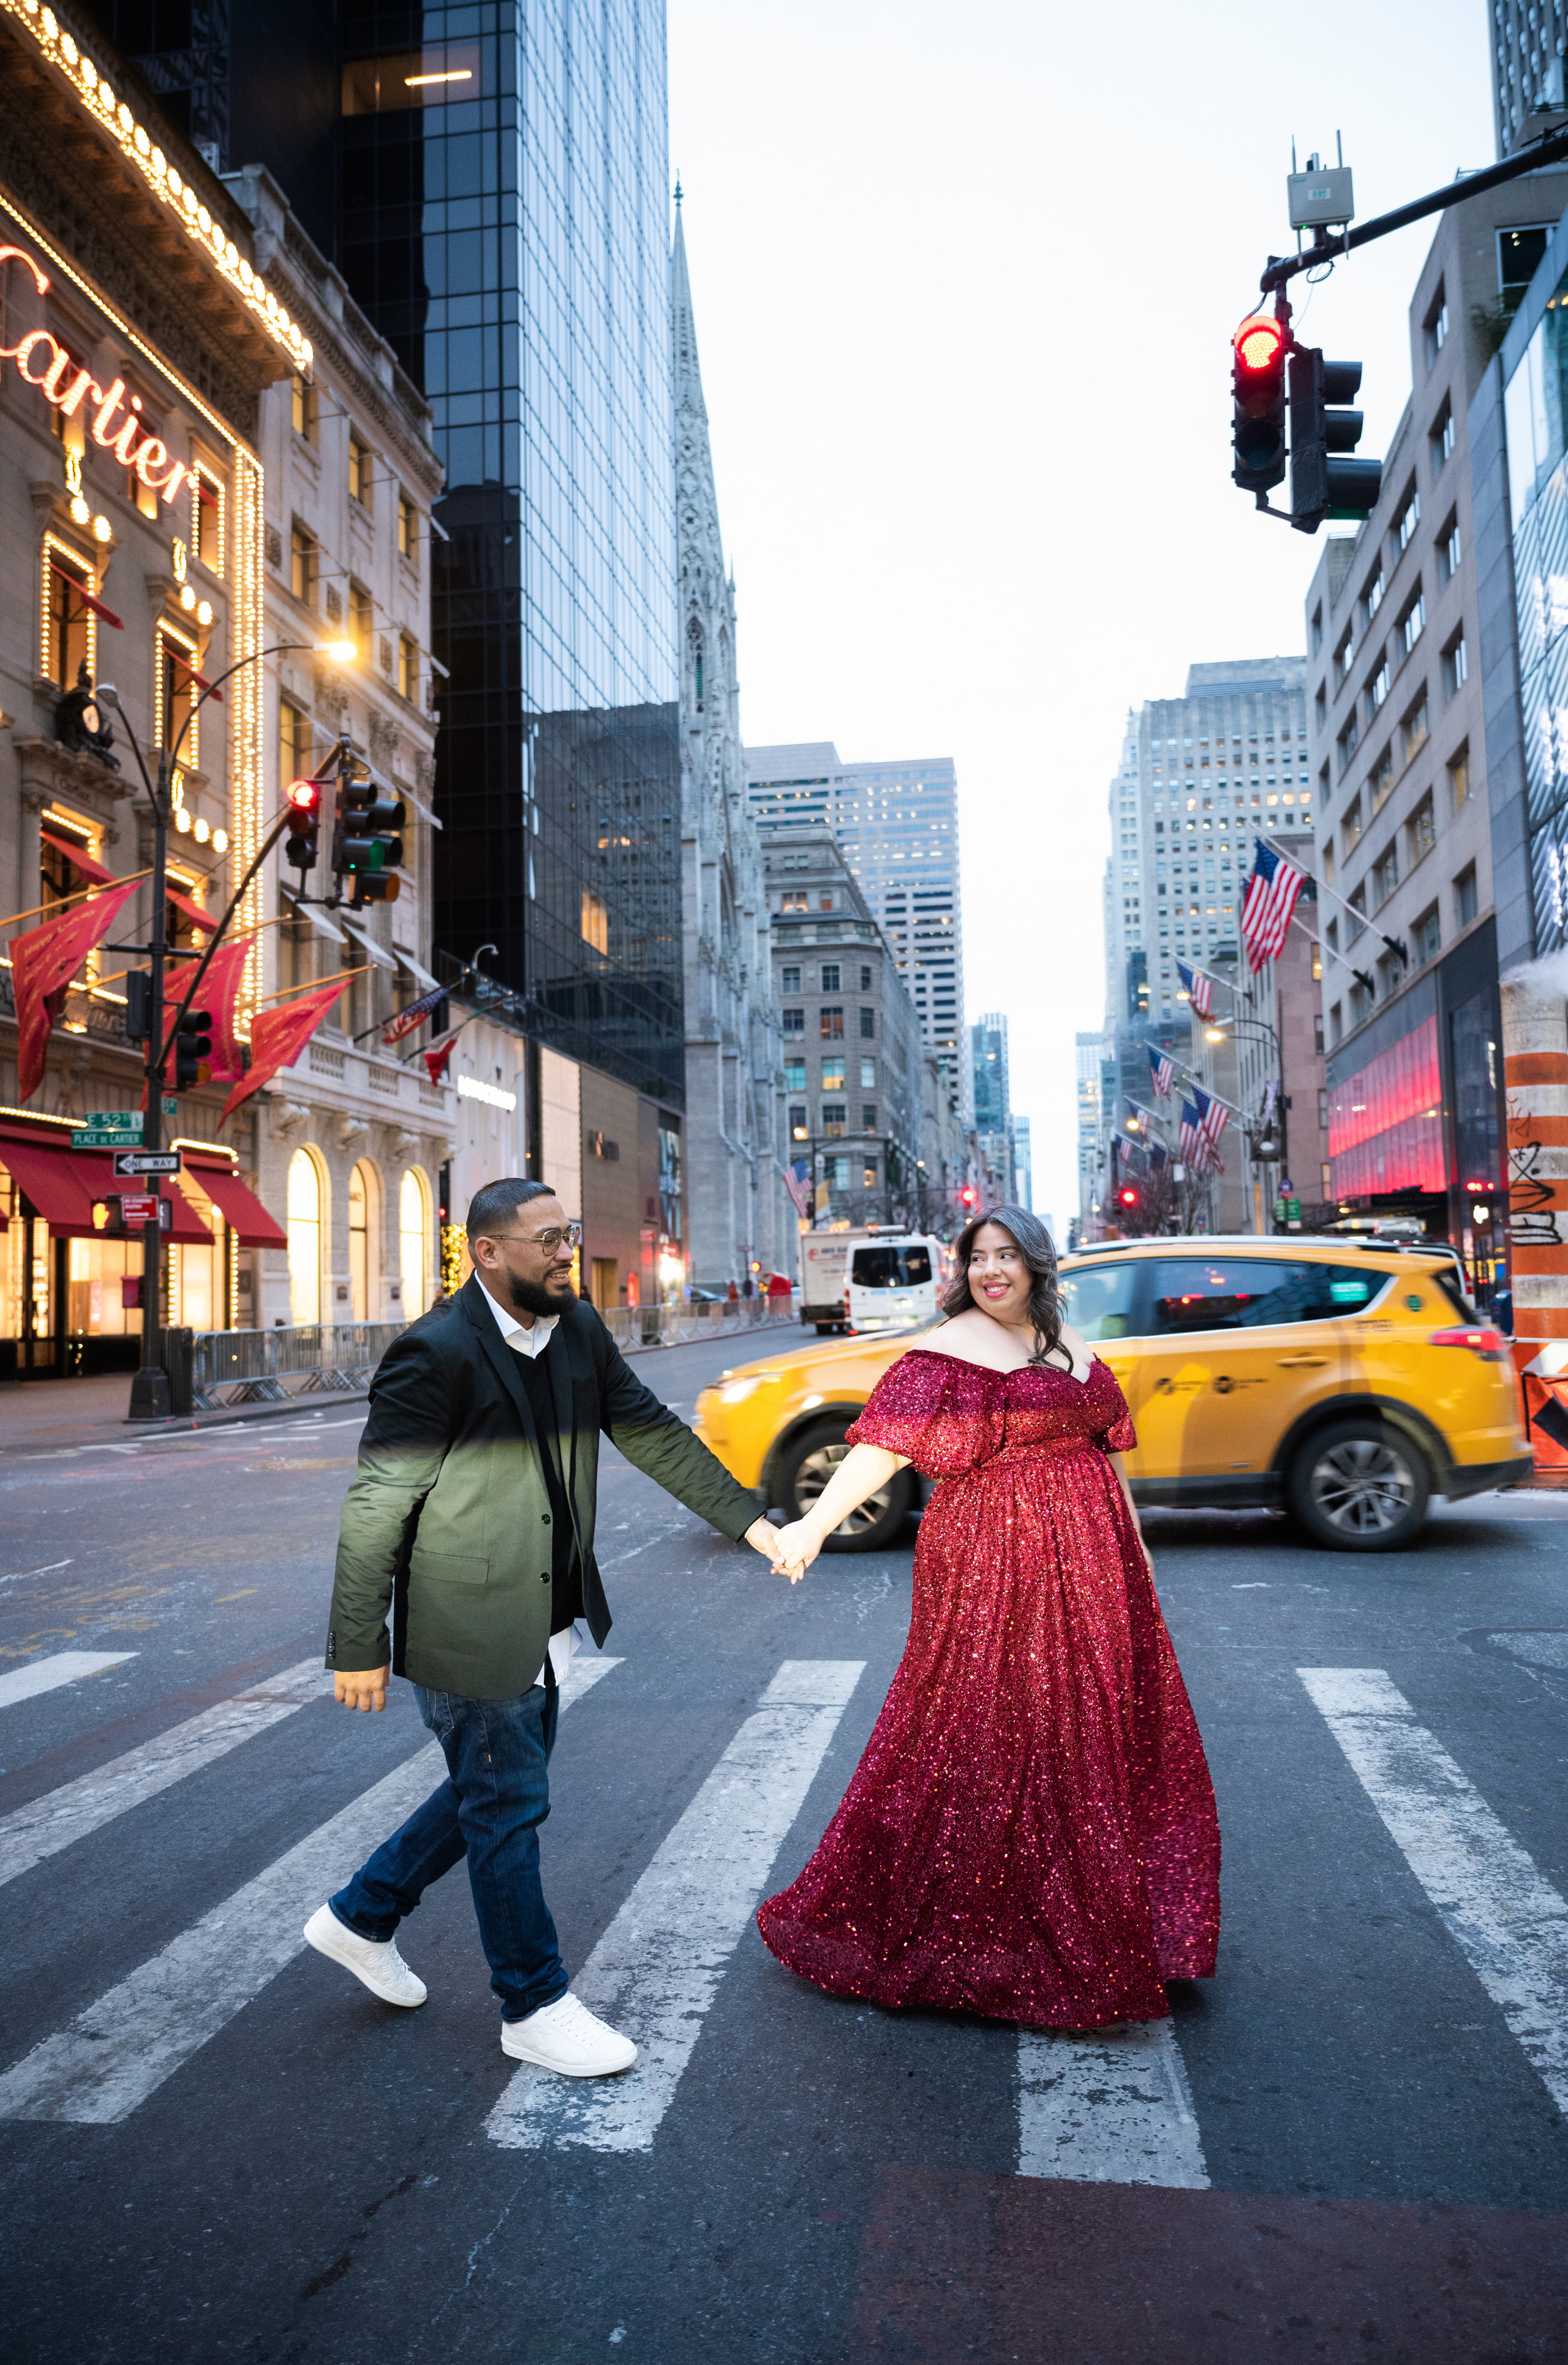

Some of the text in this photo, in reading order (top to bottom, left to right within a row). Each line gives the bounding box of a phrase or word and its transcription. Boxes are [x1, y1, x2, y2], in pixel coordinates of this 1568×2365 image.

[88, 1114, 96, 1128] E
[102, 1114, 121, 1128] 52
[74, 1134, 97, 1144] PLACE
[110, 1134, 140, 1144] CARTIER
[125, 1159, 173, 1169] ONE WAY
